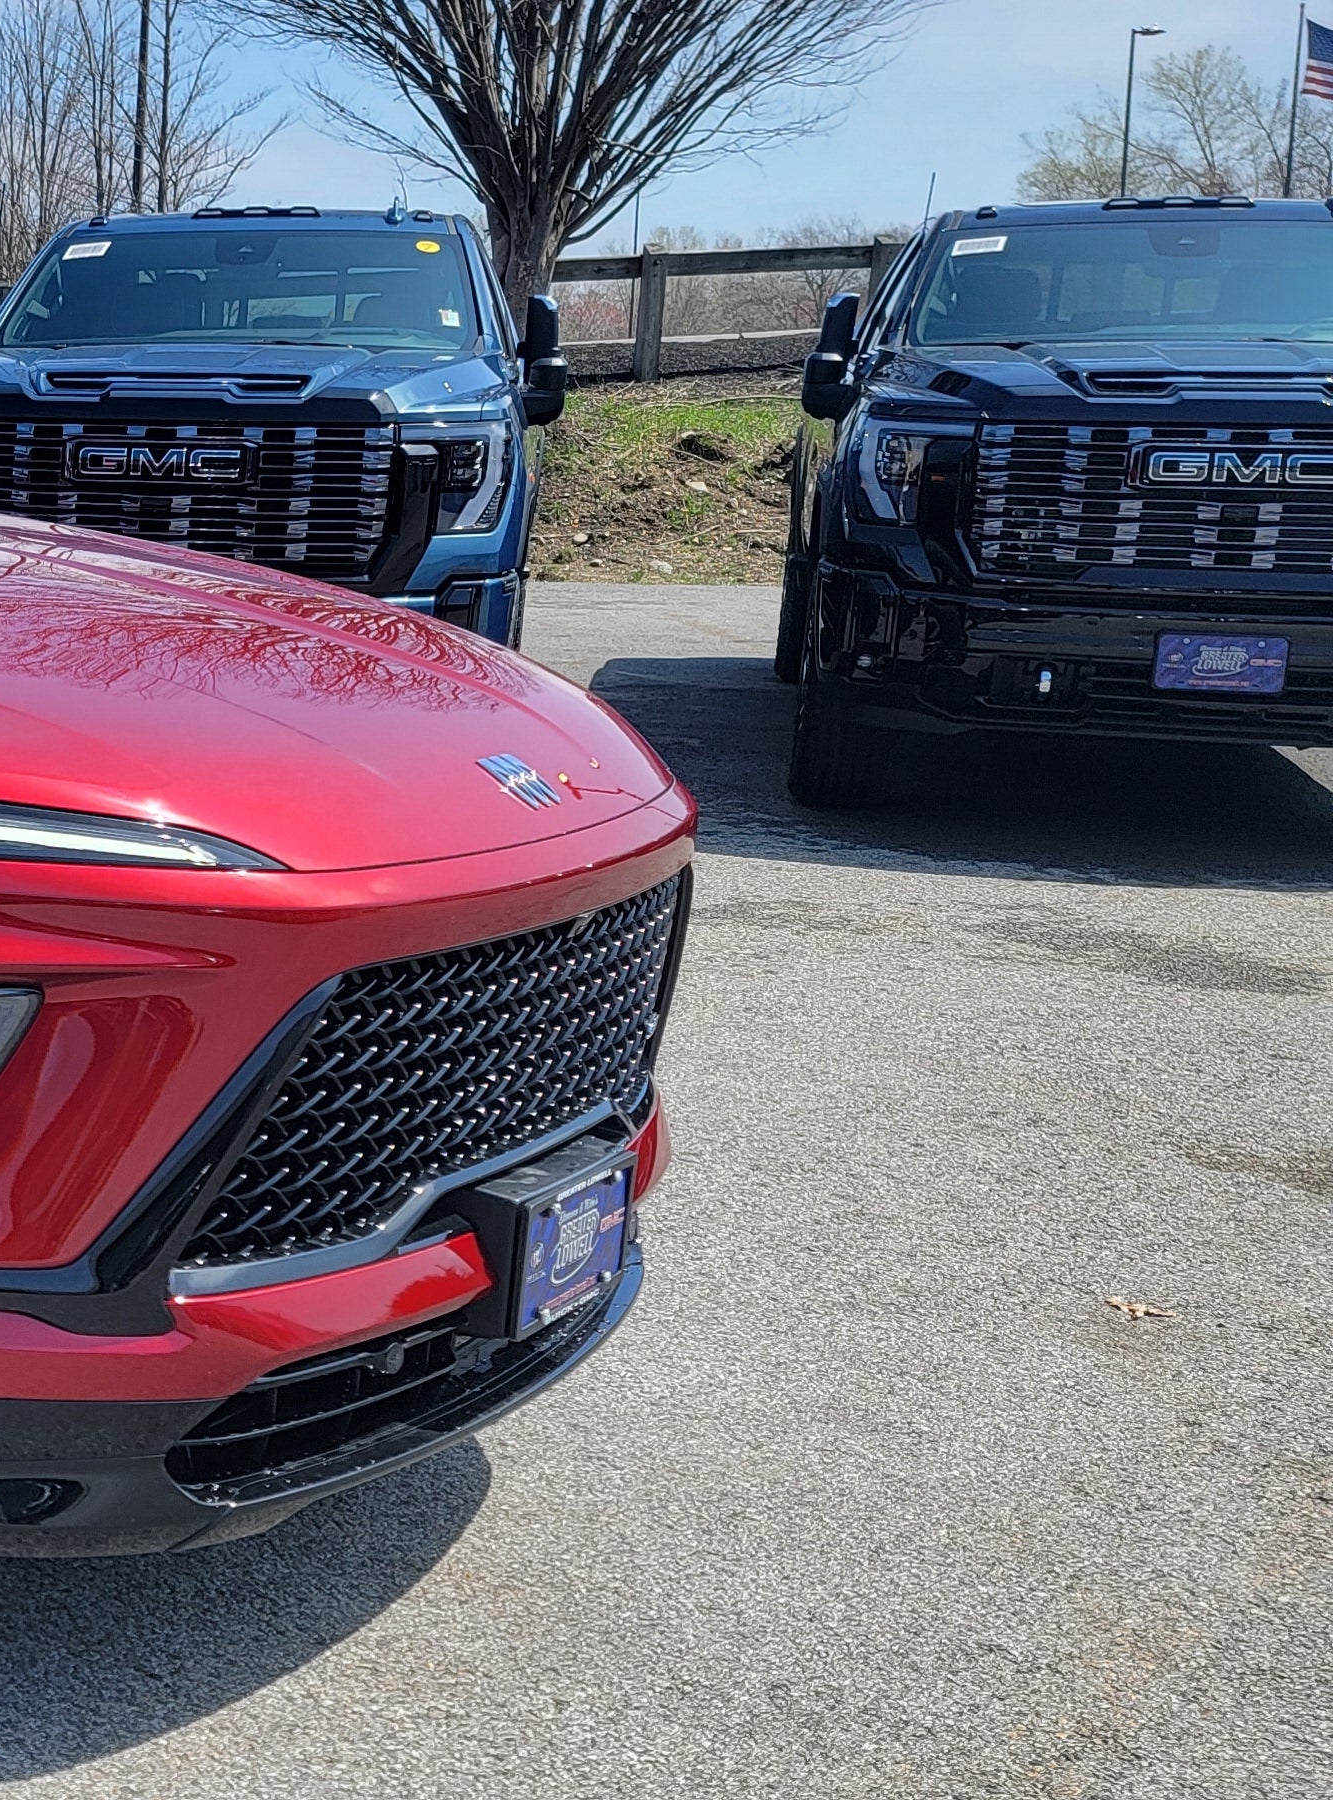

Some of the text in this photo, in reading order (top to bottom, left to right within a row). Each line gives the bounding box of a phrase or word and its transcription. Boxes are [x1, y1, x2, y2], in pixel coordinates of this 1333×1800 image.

[79, 447, 241, 478] GMC
[1149, 452, 1333, 484] GMC
[1197, 660, 1242, 671] LOWELL
[1201, 651, 1247, 663] GREATER
[557, 1168, 612, 1202] GREATER LOWELL
[560, 1209, 599, 1244] GREATER
[556, 1231, 594, 1270] LOWELL
[579, 1288, 600, 1305] GMC
